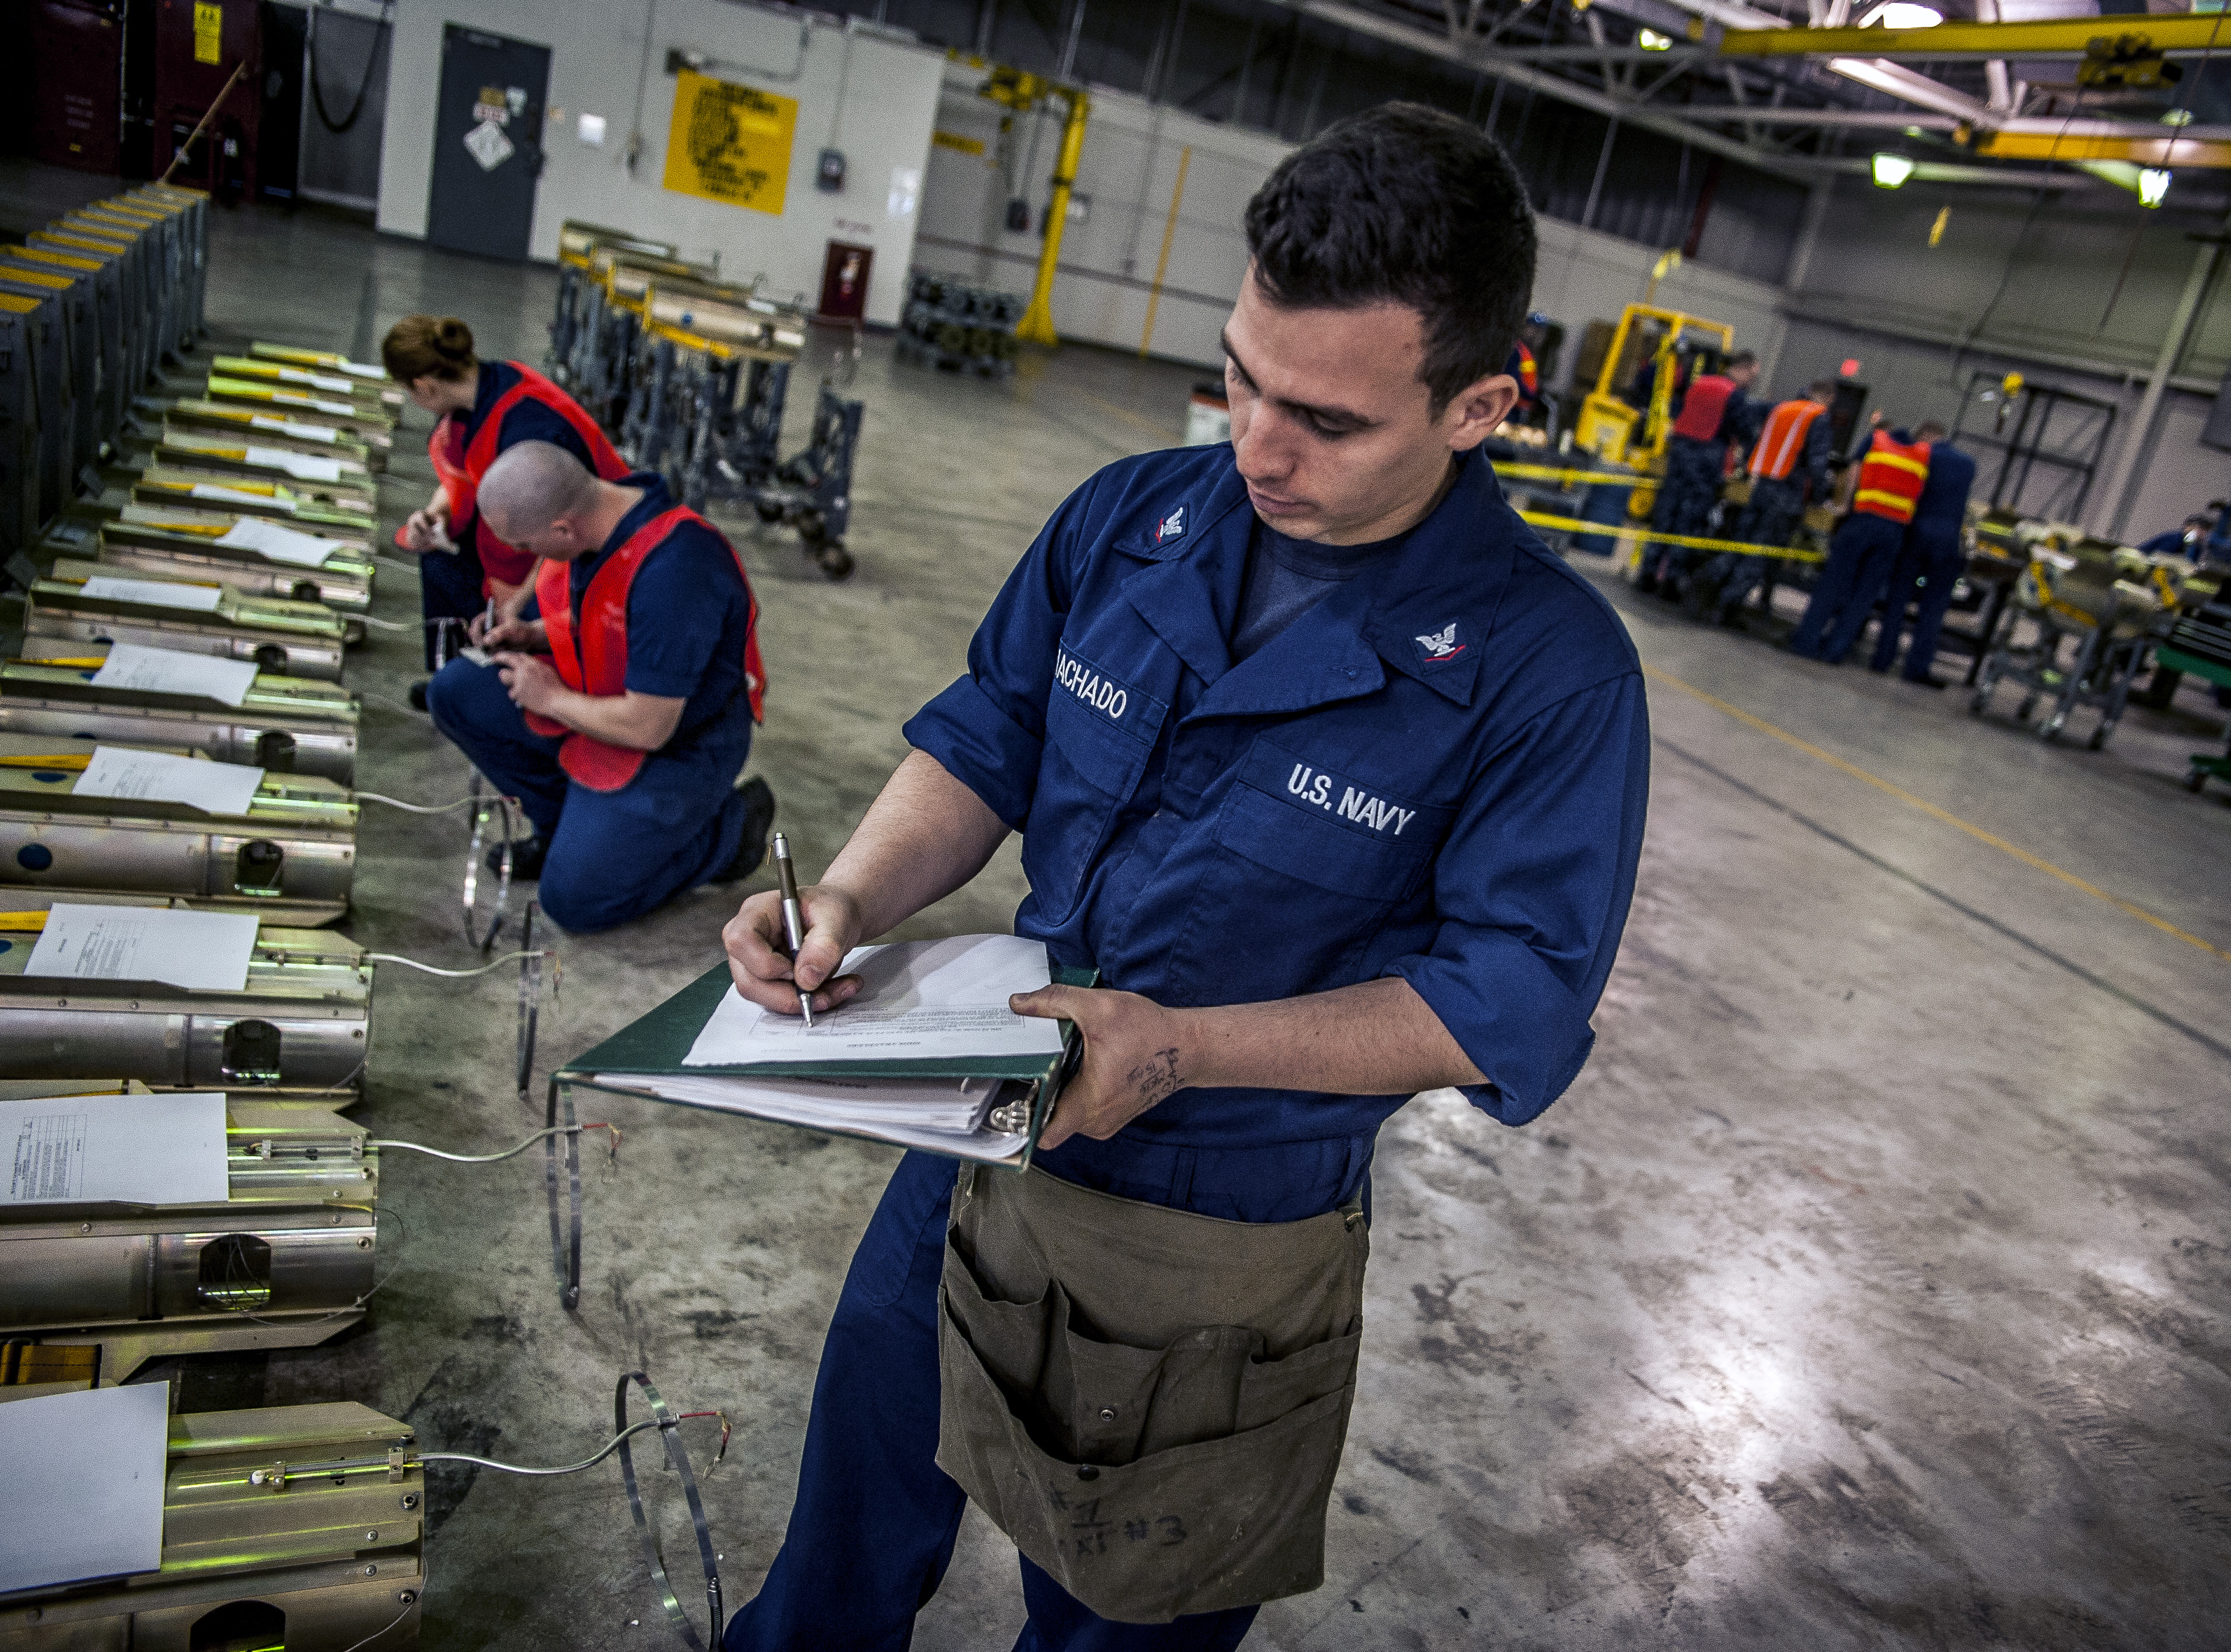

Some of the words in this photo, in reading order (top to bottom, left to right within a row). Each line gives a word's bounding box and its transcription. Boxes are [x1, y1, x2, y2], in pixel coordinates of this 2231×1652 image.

[1055, 648, 1127, 718] ACHADO
[1288, 763, 1333, 810] U.S.
[1336, 786, 1416, 835] NAVY
